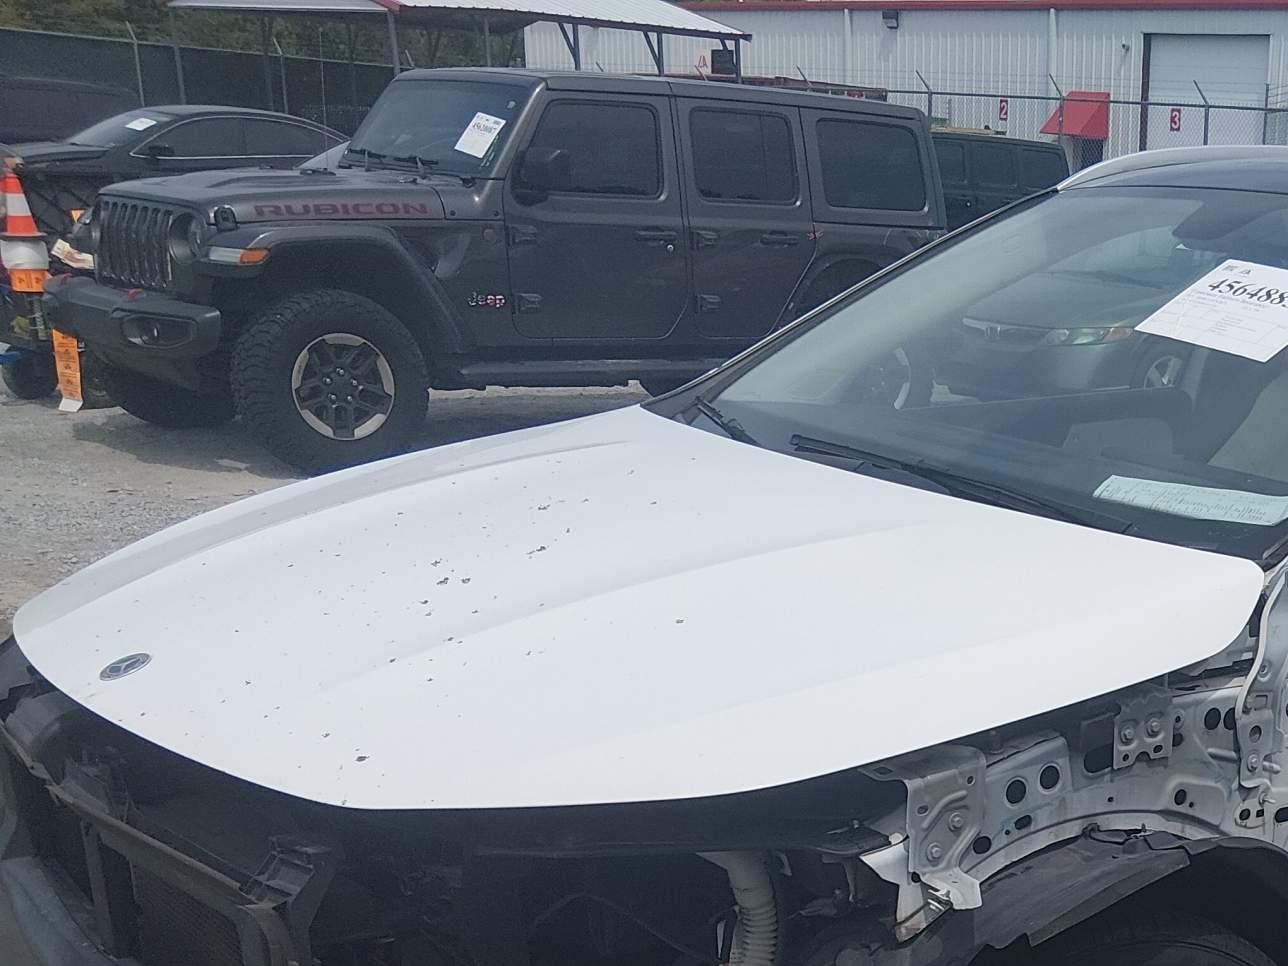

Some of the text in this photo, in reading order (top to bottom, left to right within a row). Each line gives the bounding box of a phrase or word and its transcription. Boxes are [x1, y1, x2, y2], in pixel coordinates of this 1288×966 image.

[1000, 103, 1008, 118] 2
[1171, 111, 1180, 129] 3
[253, 202, 430, 217] RUBICON
[468, 291, 505, 308] Jeep
